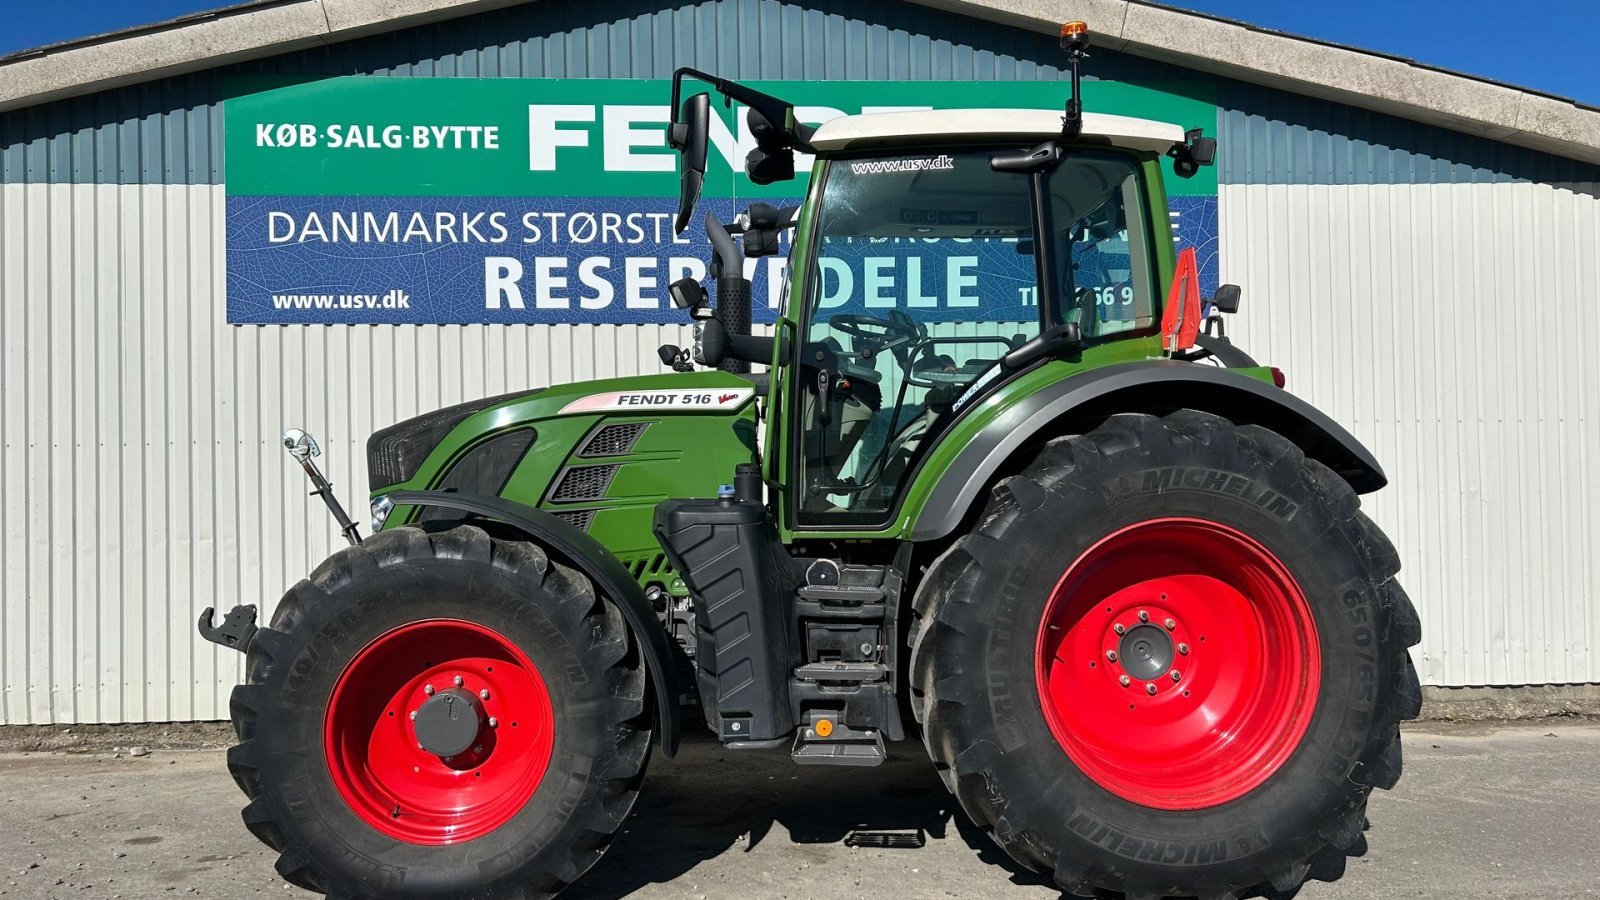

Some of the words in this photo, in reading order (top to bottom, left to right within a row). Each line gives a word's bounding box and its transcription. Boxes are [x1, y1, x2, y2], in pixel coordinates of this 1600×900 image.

[528, 104, 933, 172] FEN
[851, 154, 954, 175] www.usv.dk
[268, 211, 508, 244] DANMARKS
[272, 289, 410, 309] www.usv.dk
[617, 394, 677, 405] FENDT
[681, 393, 712, 404] 516
[1142, 467, 1297, 522] MICHELIN
[1068, 813, 1229, 863] MICHELIN
